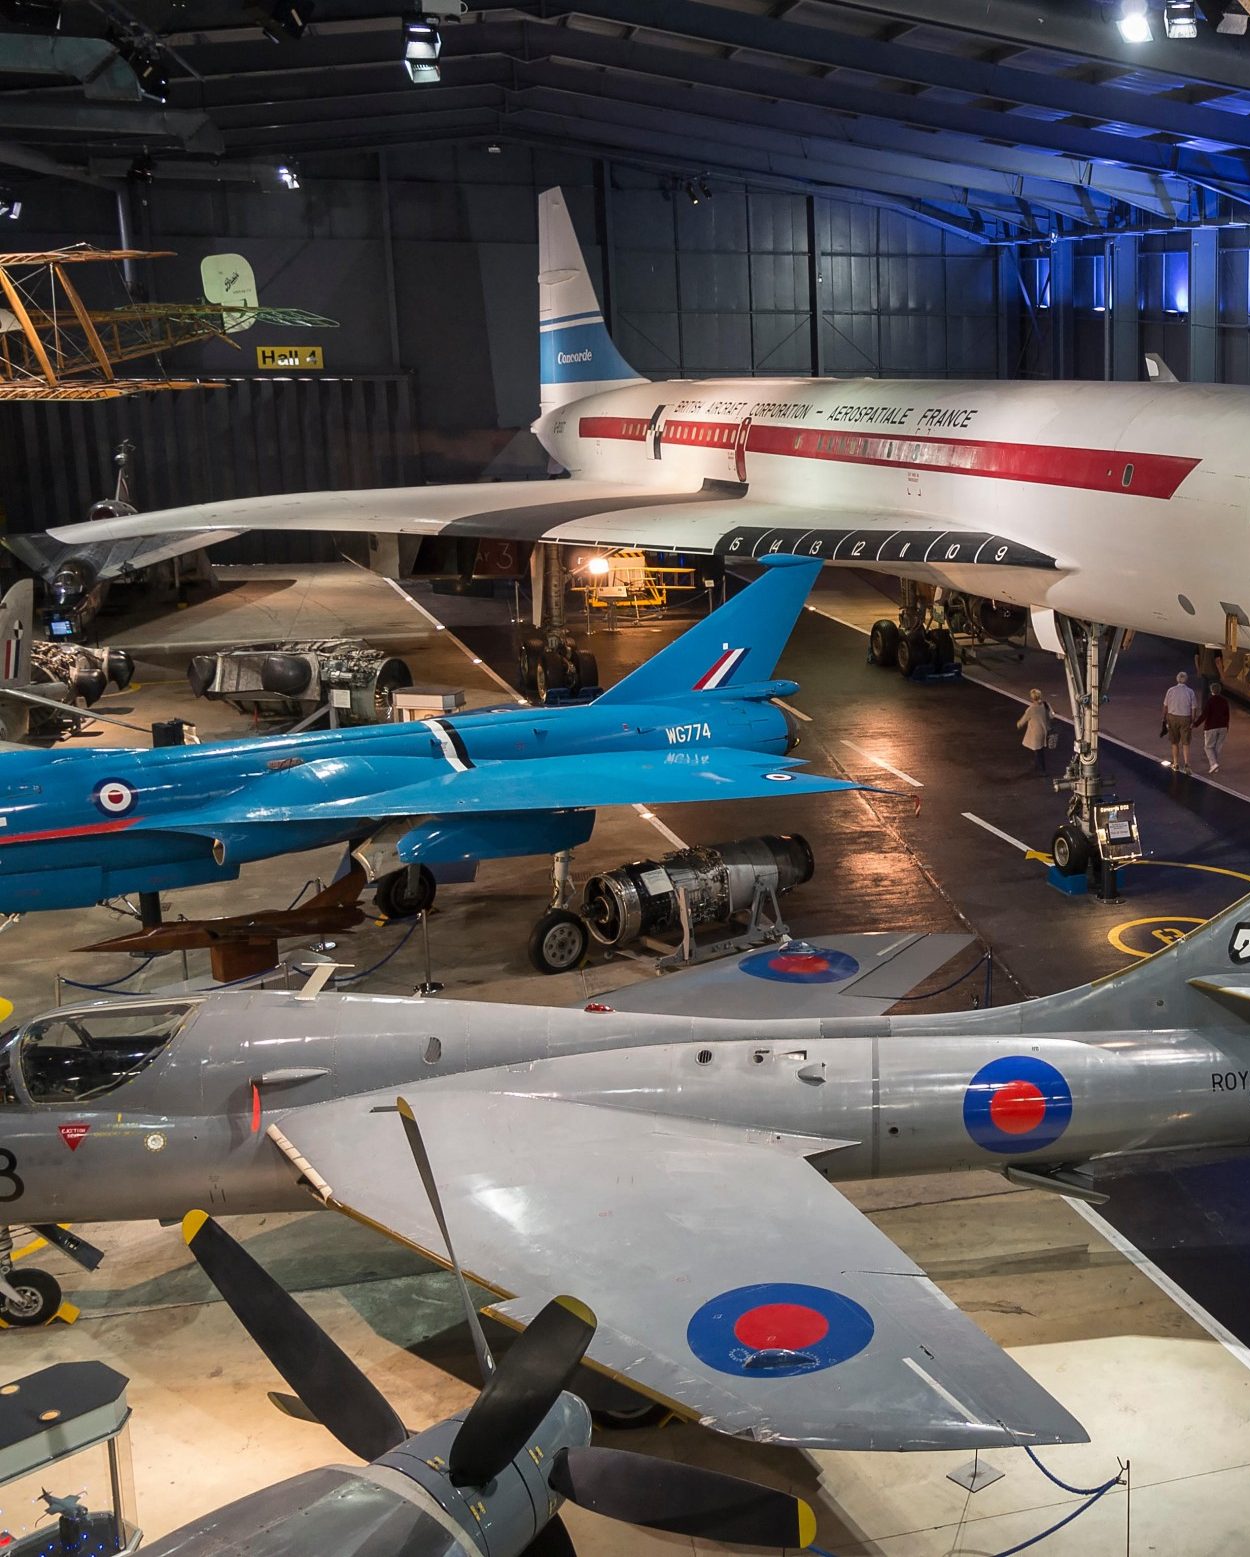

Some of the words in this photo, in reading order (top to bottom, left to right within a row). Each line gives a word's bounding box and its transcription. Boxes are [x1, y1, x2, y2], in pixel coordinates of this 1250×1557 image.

[261, 350, 299, 366] Hall
[306, 350, 317, 366] 4
[557, 349, 593, 365] Concorde
[707, 401, 748, 415] AIRCRAFT
[749, 402, 813, 420] CORPORATION
[827, 405, 914, 425] AEROSPATIALE
[916, 408, 978, 428] FRANCE
[496, 543, 513, 569] 3
[729, 537, 741, 551] 15
[768, 539, 782, 553] 14
[808, 540, 822, 554] 13
[851, 540, 865, 556] 12
[899, 542, 910, 557] 11
[946, 544, 960, 559] 10
[995, 546, 1008, 561] 9
[665, 723, 711, 744] WG774
